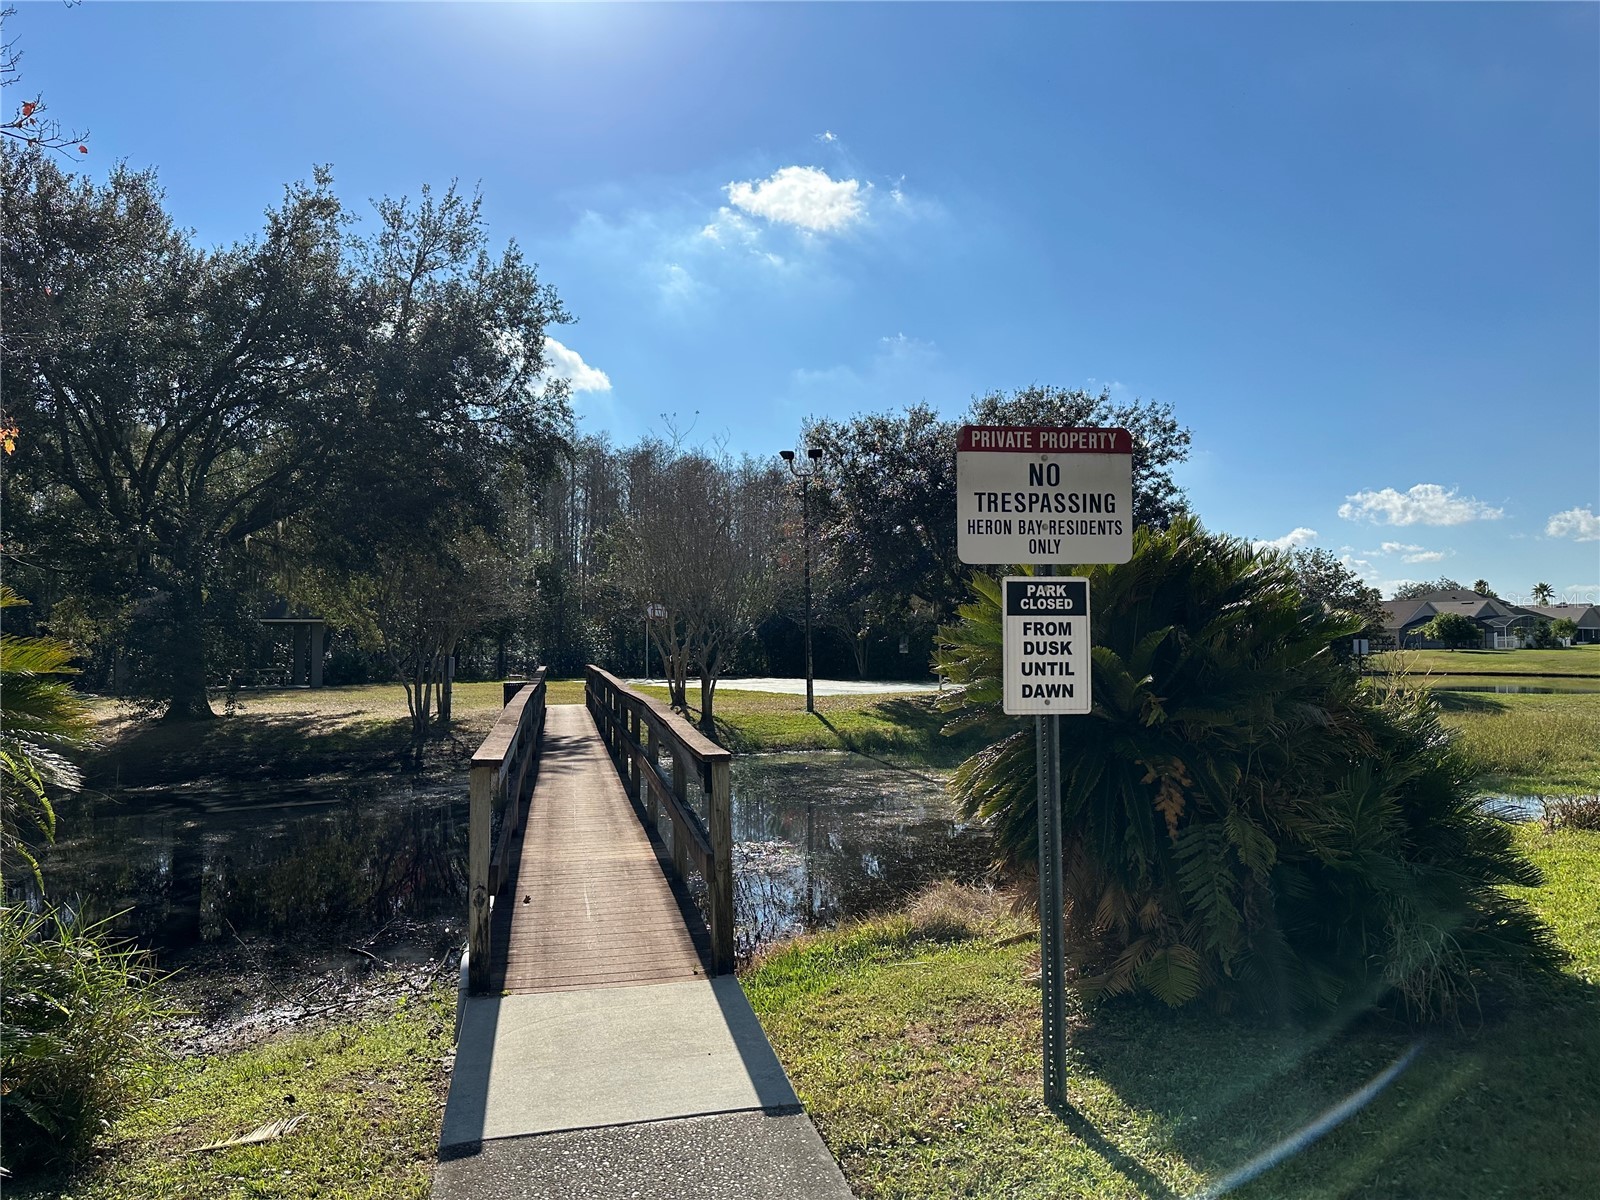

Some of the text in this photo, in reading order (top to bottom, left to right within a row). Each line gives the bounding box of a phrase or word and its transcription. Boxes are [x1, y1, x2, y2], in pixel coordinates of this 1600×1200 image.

[971, 430, 1117, 449] PRIVATE PROPERTY
[1029, 463, 1061, 487] NO
[974, 492, 1116, 514] TRESPASSING
[967, 519, 1123, 536] HERON BAY RESIDENTS
[1029, 539, 1061, 554] ONLY
[1027, 585, 1067, 597] PARK
[1020, 599, 1073, 610] CLOSED
[1023, 622, 1072, 636] FROM
[1023, 641, 1073, 655] DUSK
[1021, 662, 1075, 676] UNTIL
[1022, 684, 1074, 698] DAWN
